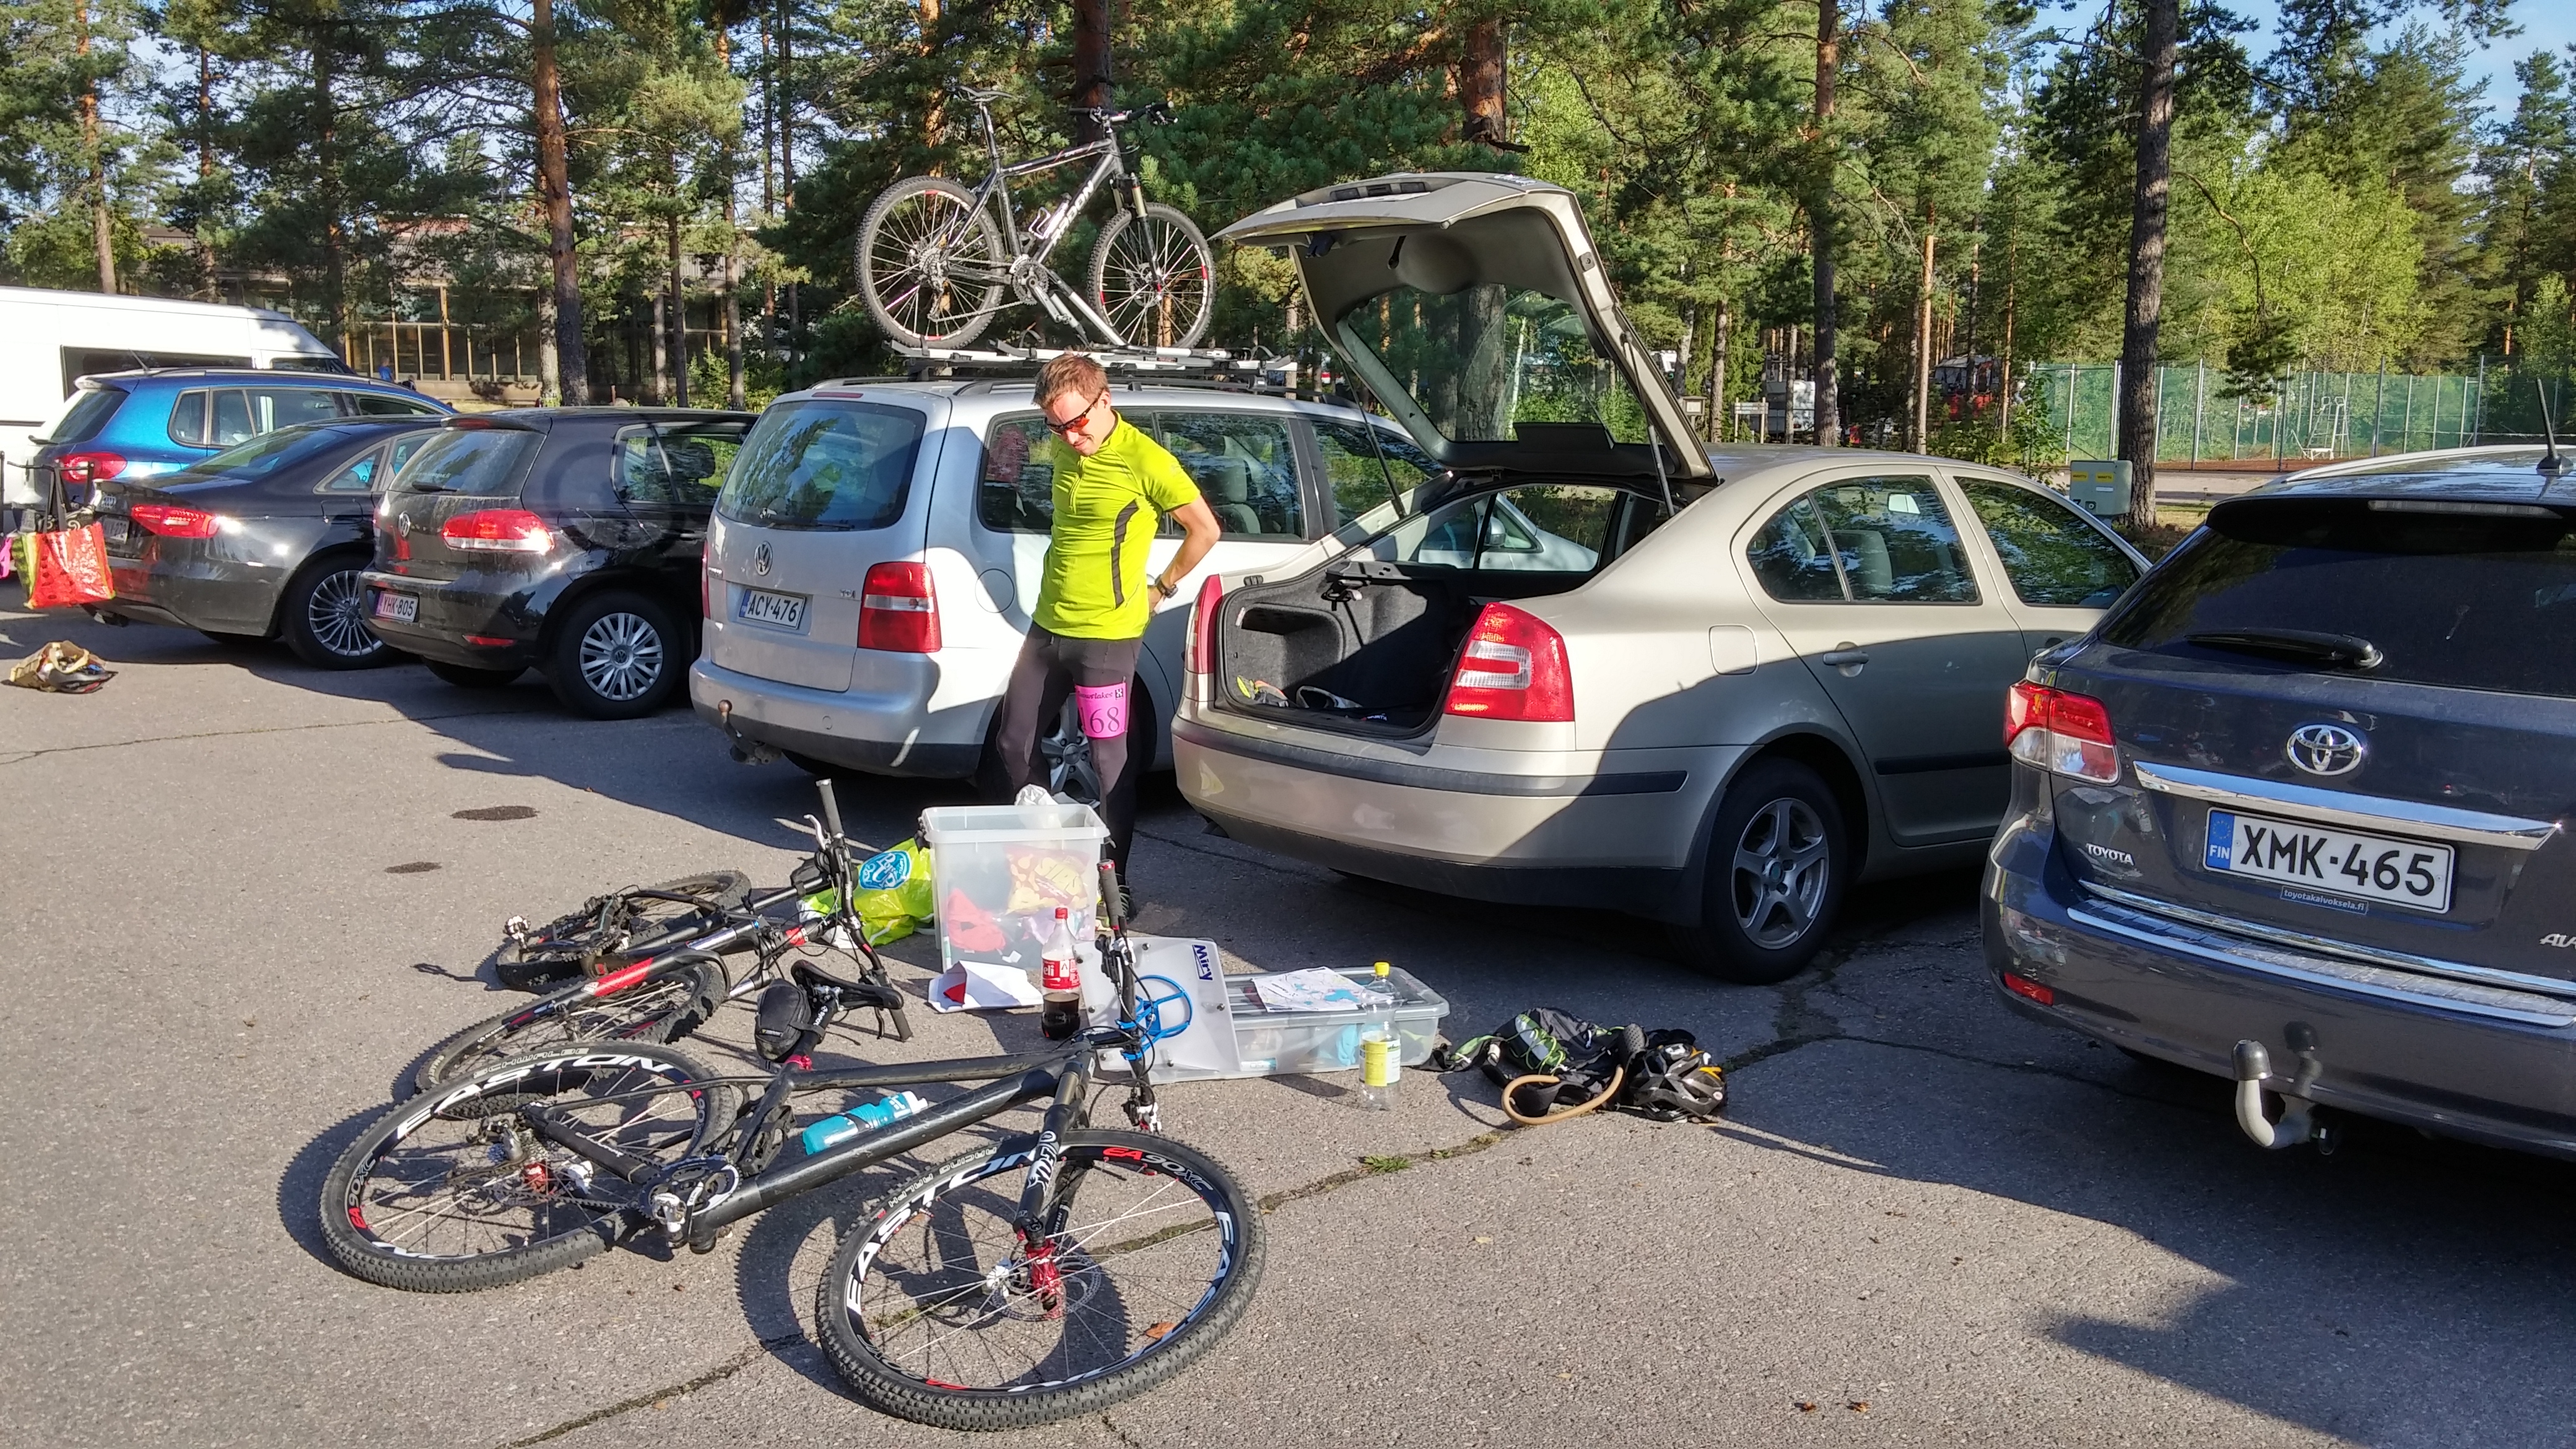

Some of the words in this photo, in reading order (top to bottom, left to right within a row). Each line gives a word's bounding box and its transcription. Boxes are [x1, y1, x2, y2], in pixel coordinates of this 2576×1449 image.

[382, 596, 414, 617] YHK-805
[747, 594, 799, 622] ACY-476
[2086, 843, 2134, 866] TOYOTA
[2209, 845, 2230, 860] FIN
[2240, 825, 2435, 896] XMK-465
[2283, 889, 2365, 912] toyotakaivoksela.fi
[473, 1047, 590, 1079] SCHWALBE
[397, 1055, 674, 1139] EASTON
[939, 1147, 998, 1175] RACING
[1103, 1147, 1213, 1191] EA90XC
[349, 1152, 376, 1229] EA90XC
[888, 1173, 934, 1208] RALPH
